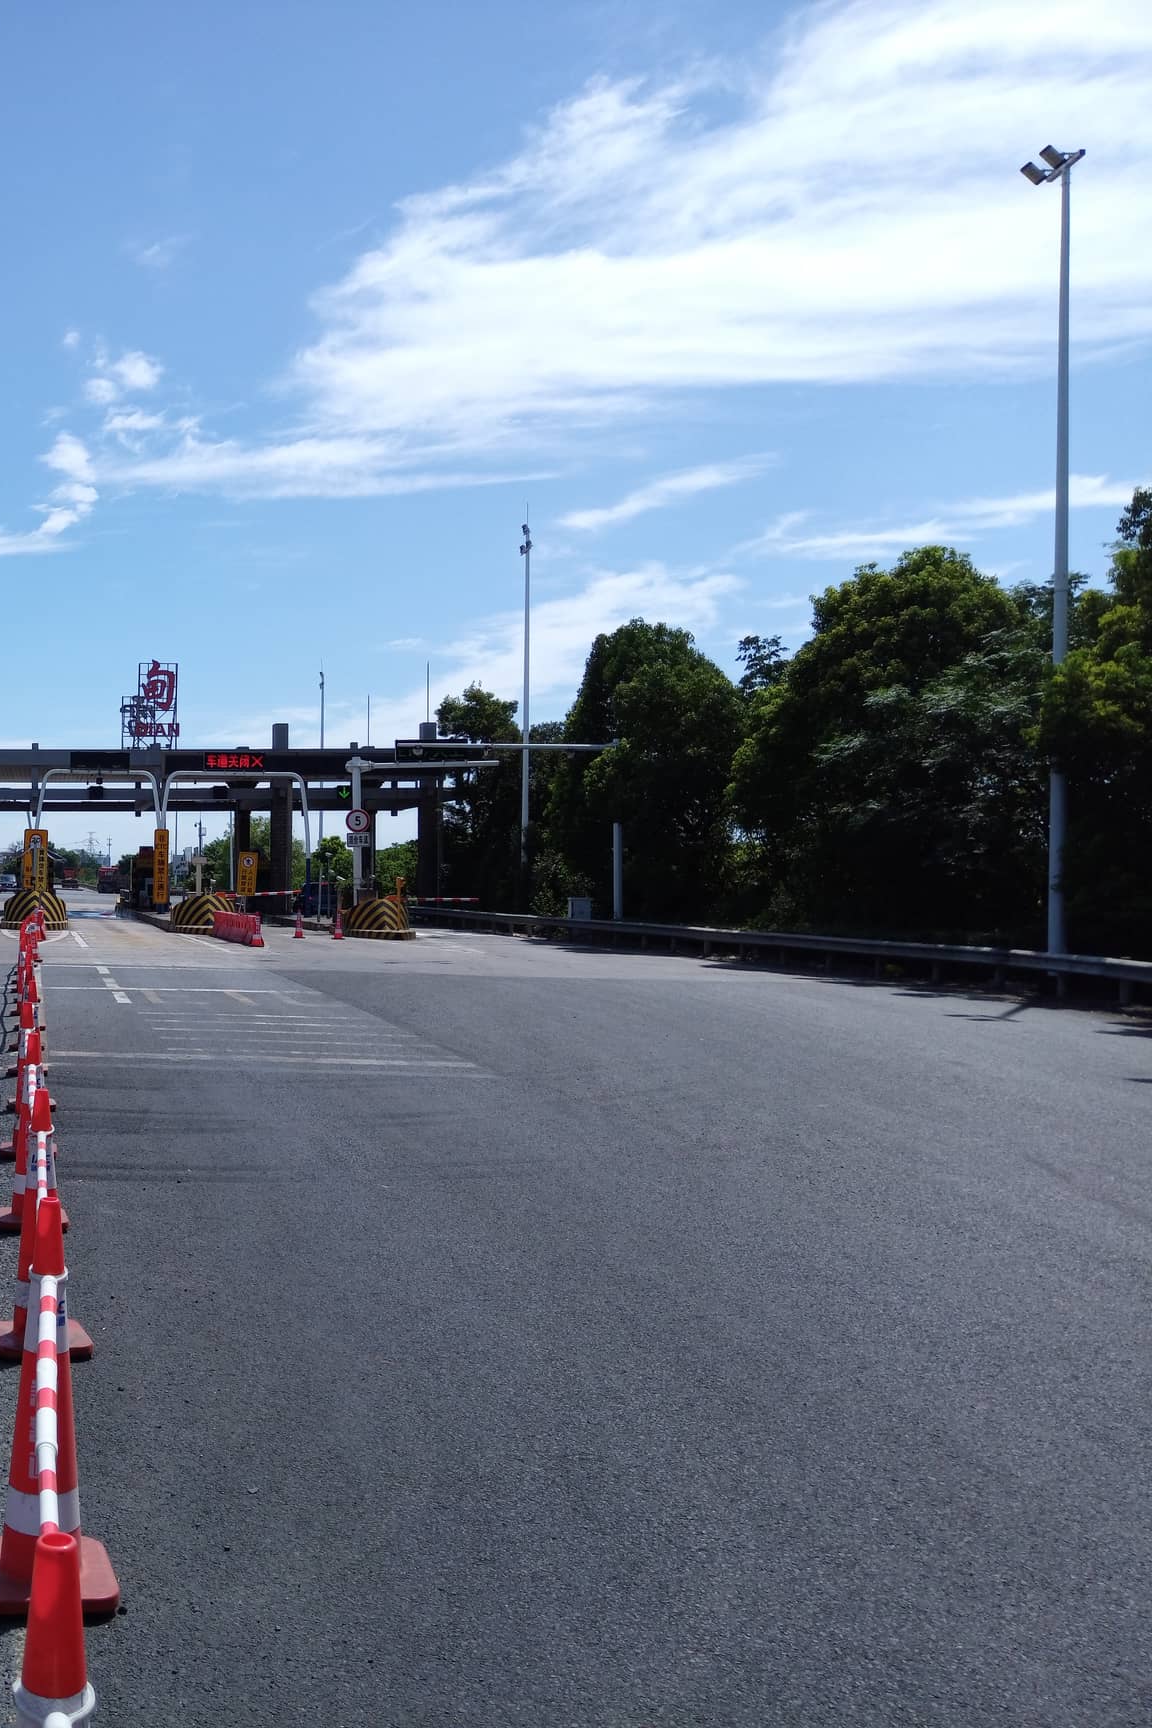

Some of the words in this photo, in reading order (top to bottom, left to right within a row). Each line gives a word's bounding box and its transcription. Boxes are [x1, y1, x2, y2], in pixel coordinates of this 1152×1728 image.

[207, 754, 250, 768] 车道关闭
[355, 816, 361, 826] 5
